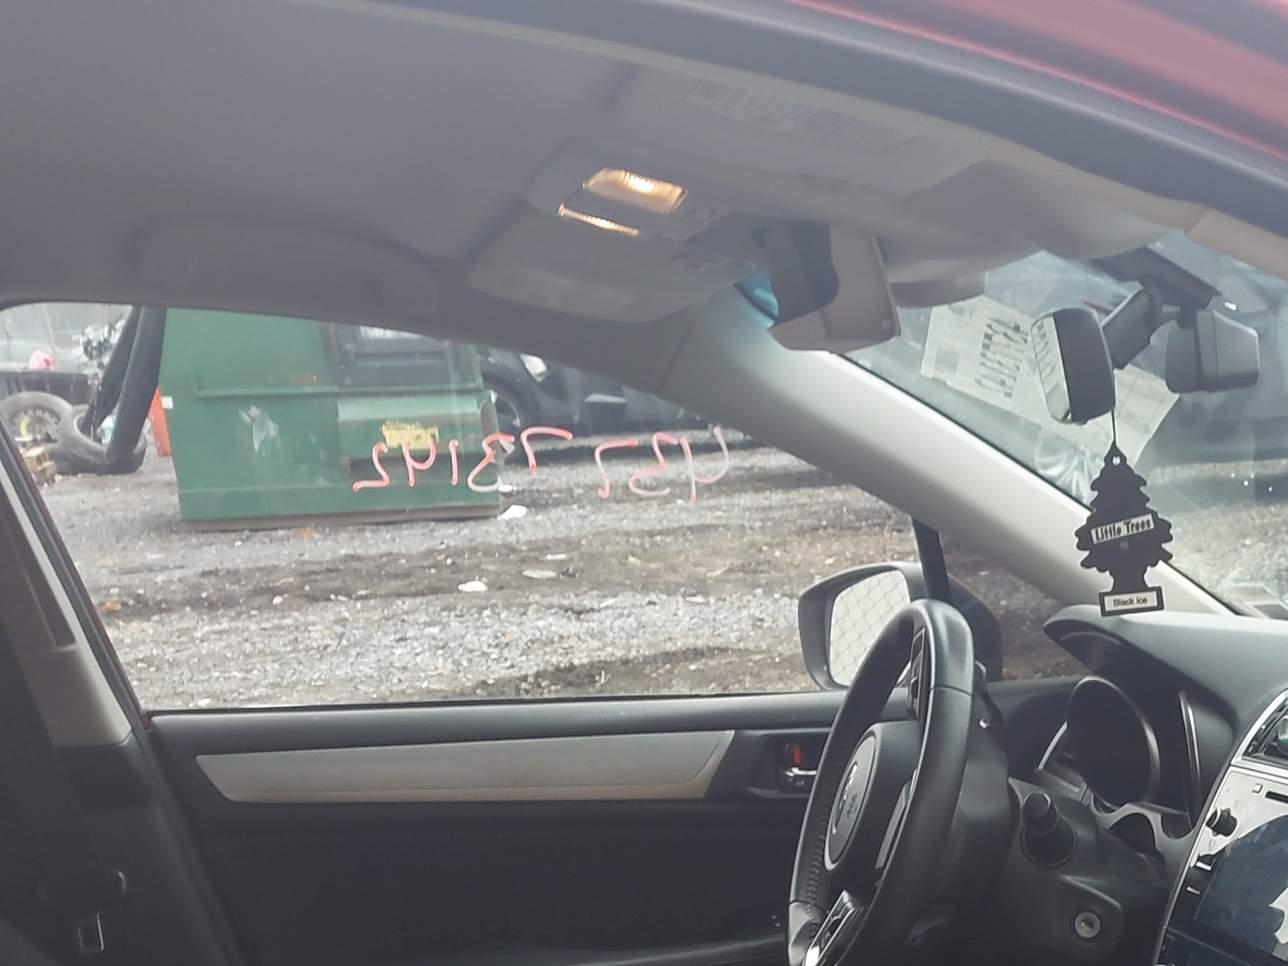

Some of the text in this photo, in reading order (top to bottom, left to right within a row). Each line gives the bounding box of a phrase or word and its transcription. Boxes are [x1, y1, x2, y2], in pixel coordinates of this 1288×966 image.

[1094, 518, 1151, 541] Little Trees
[1112, 597, 1135, 608] Black
